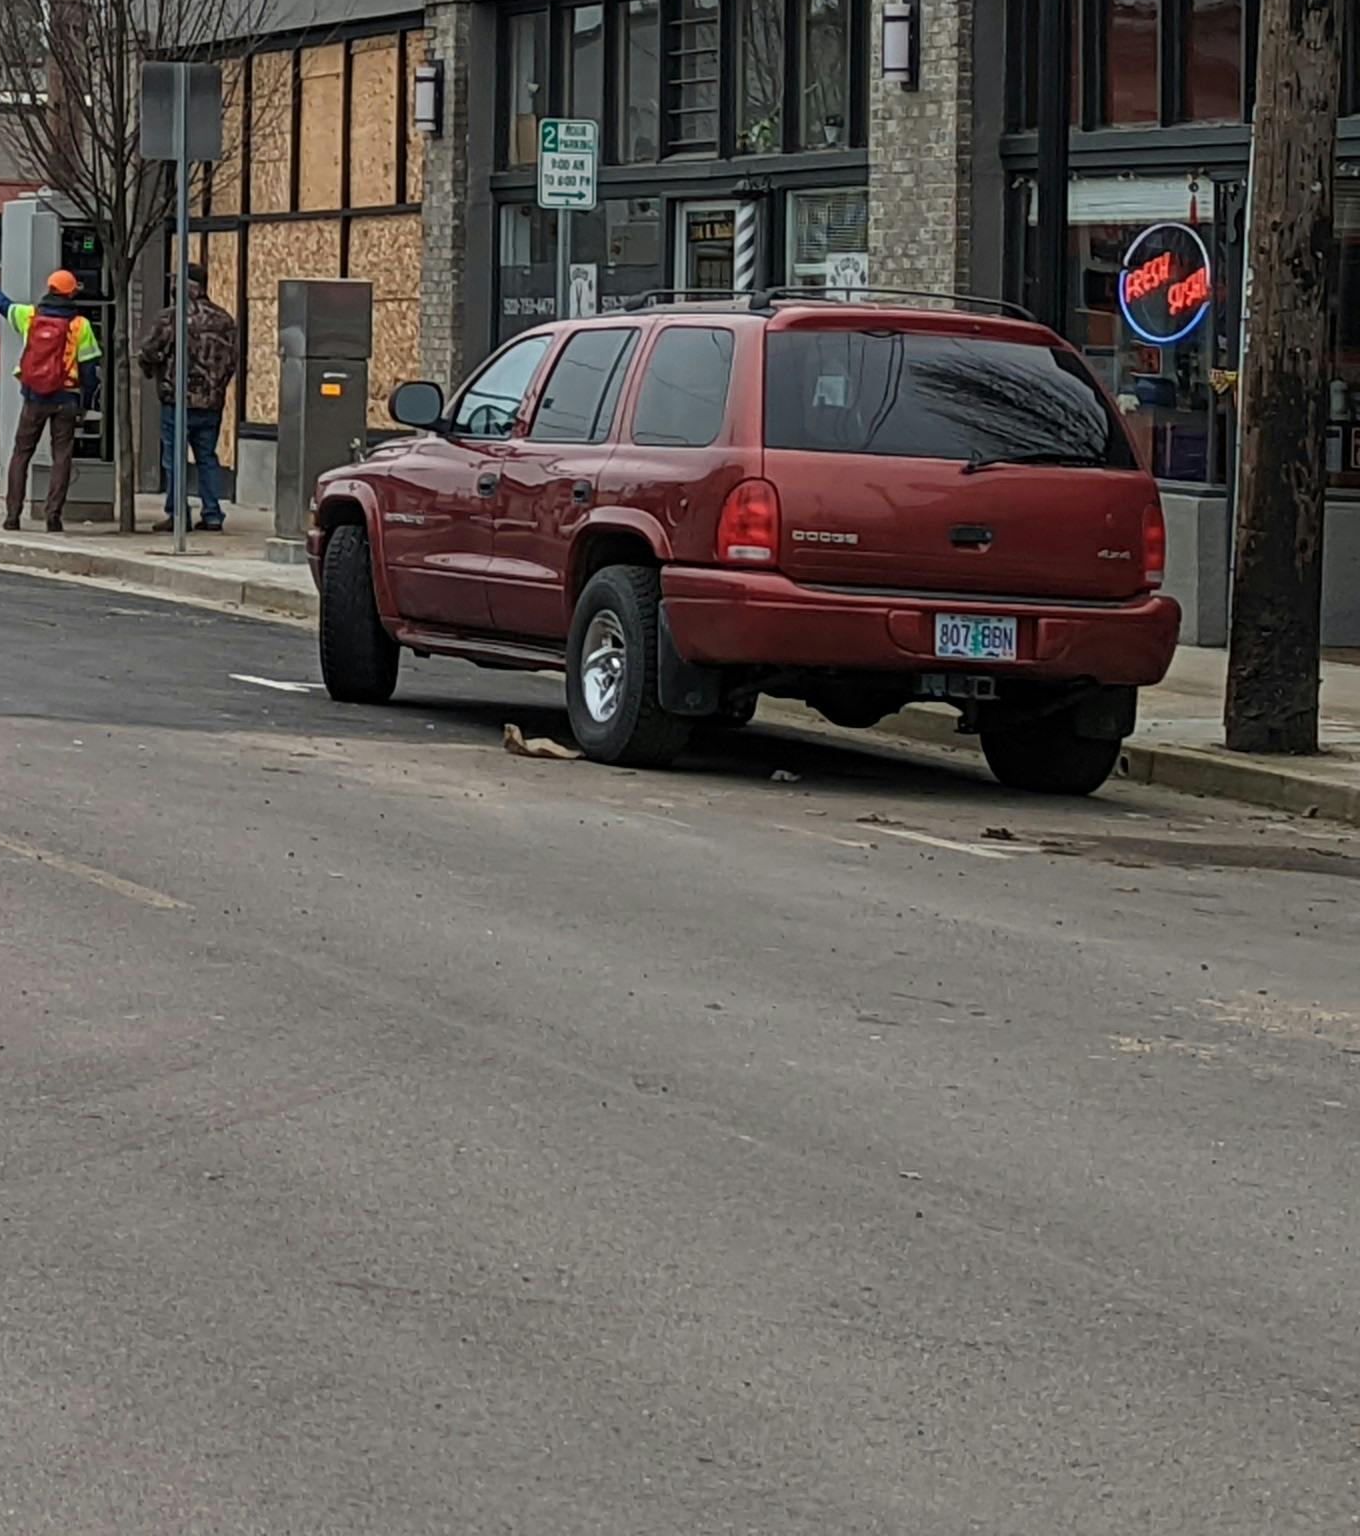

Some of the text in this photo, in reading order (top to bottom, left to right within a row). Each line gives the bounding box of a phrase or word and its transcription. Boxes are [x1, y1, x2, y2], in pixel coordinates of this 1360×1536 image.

[542, 125, 557, 149] 2
[543, 174, 555, 186] TO
[1124, 250, 1172, 305] FRESH
[791, 529, 859, 545] DODGE
[939, 623, 971, 648] 807
